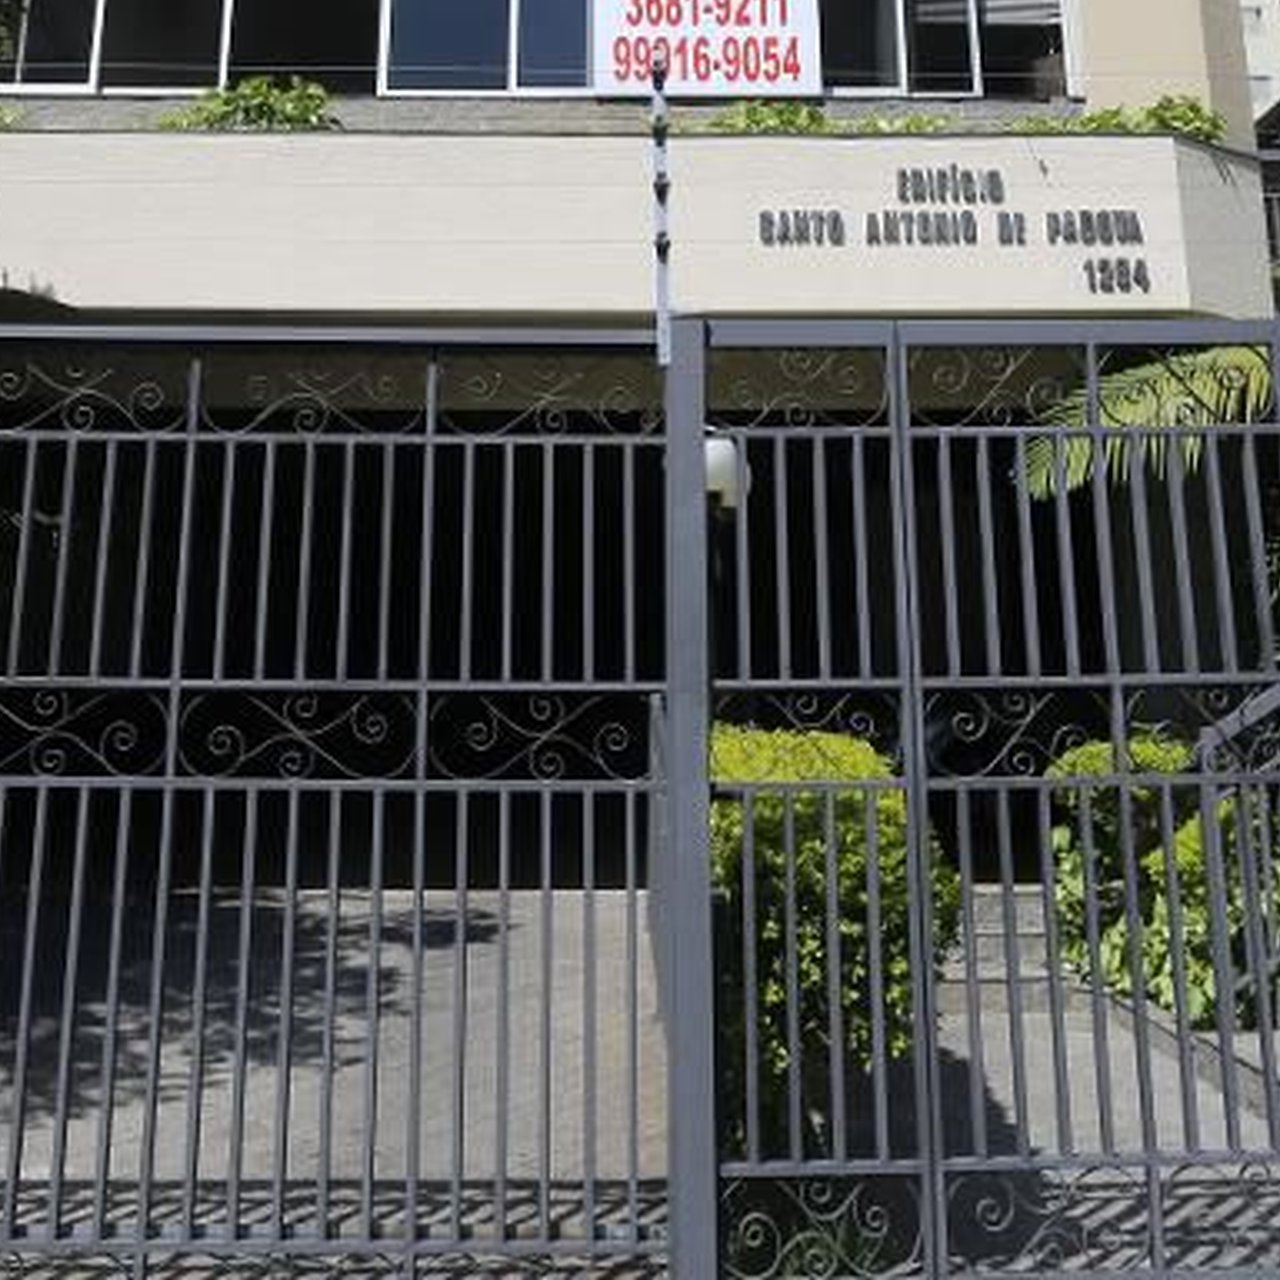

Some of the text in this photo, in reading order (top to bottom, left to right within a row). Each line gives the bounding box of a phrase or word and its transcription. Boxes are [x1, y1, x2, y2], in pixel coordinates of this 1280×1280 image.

[759, 210, 845, 246] SANTO
[865, 210, 978, 246] ANTONIO
[997, 211, 1026, 246] DE
